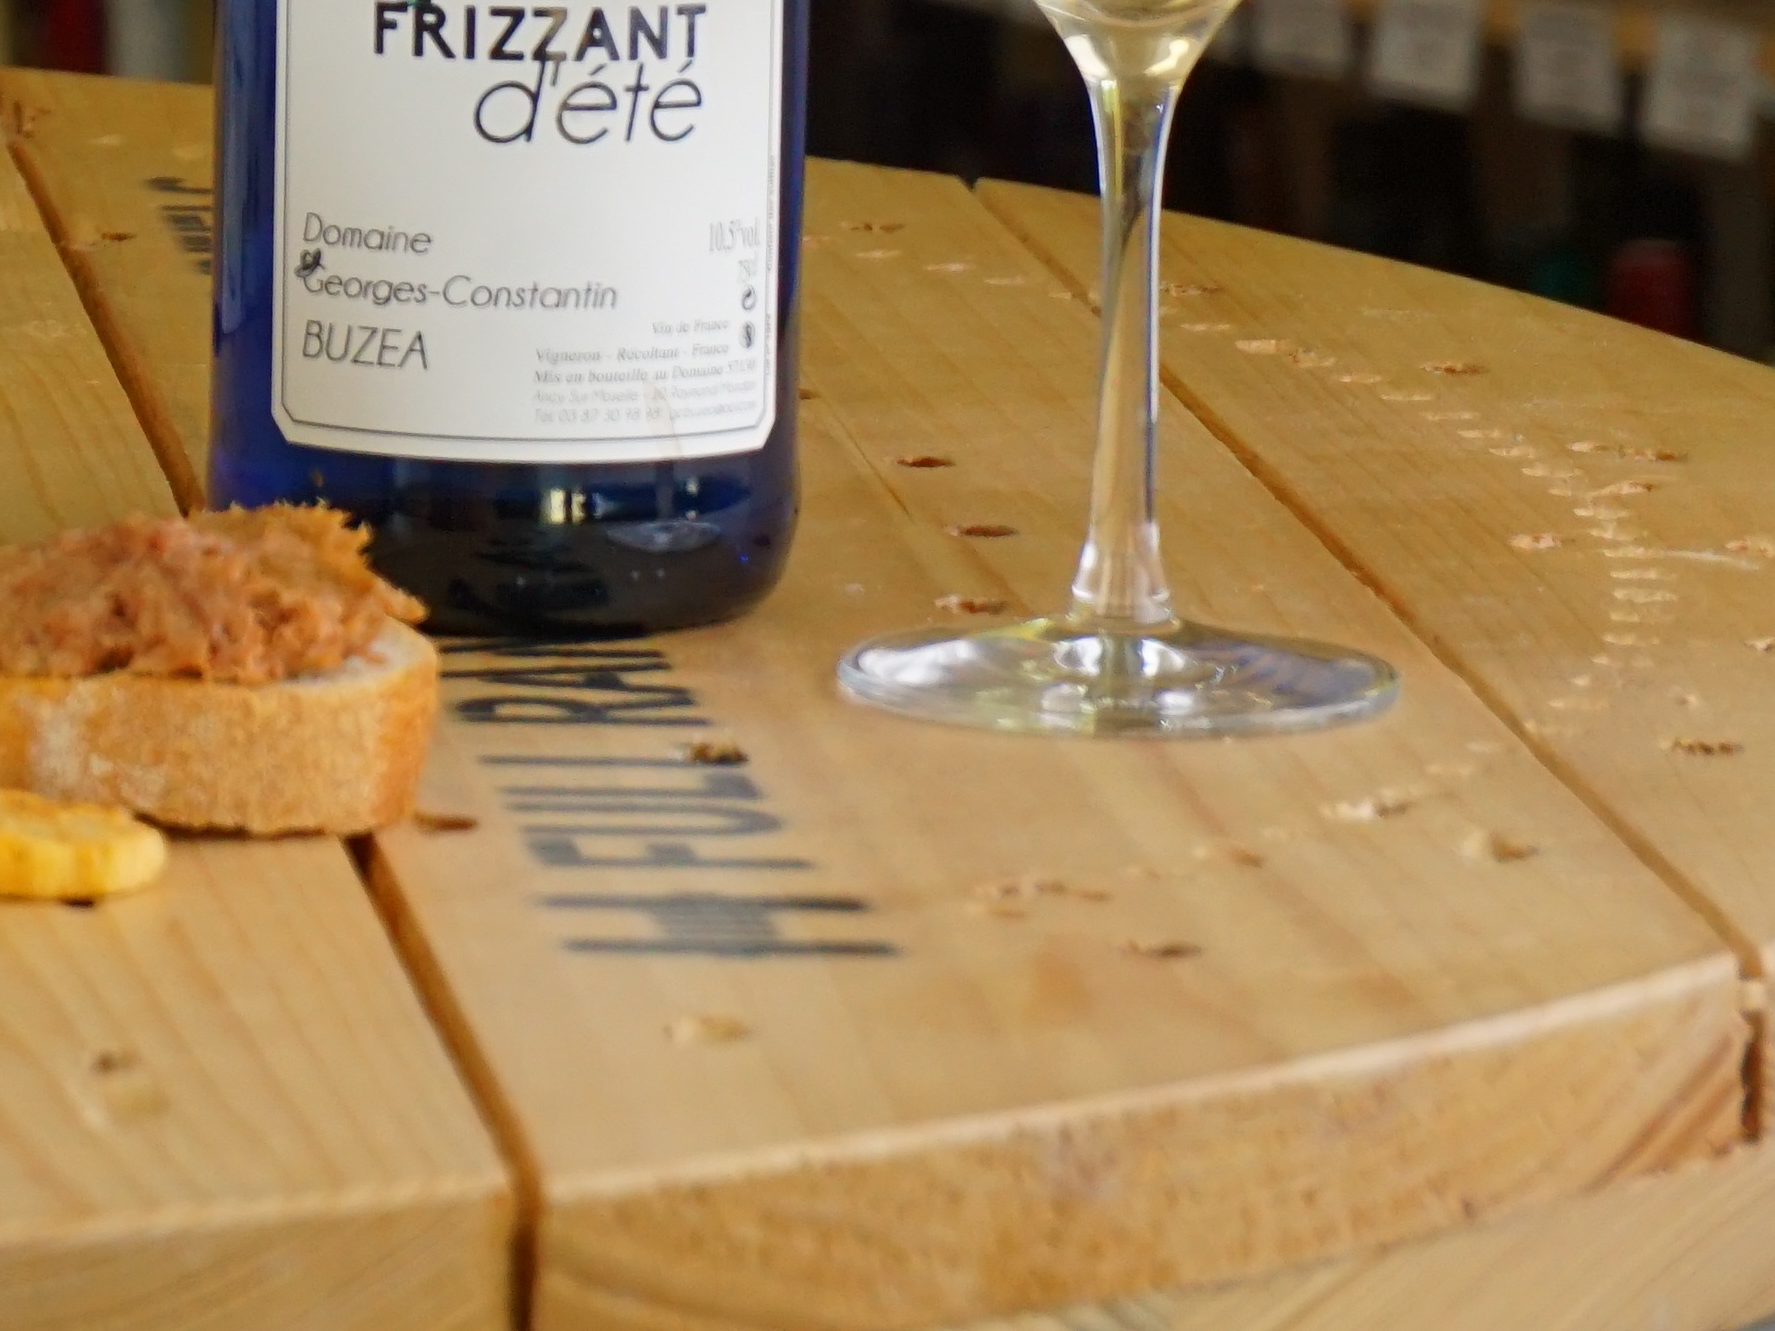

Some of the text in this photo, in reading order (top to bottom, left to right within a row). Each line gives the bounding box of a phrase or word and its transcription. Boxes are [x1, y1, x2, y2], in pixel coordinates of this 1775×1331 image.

[373, 0, 707, 63] FRIZZANT
[473, 60, 703, 145] d'été
[302, 211, 433, 255] Domaine
[300, 269, 620, 311] Georges-Constantin
[302, 318, 429, 370] BUZEA
